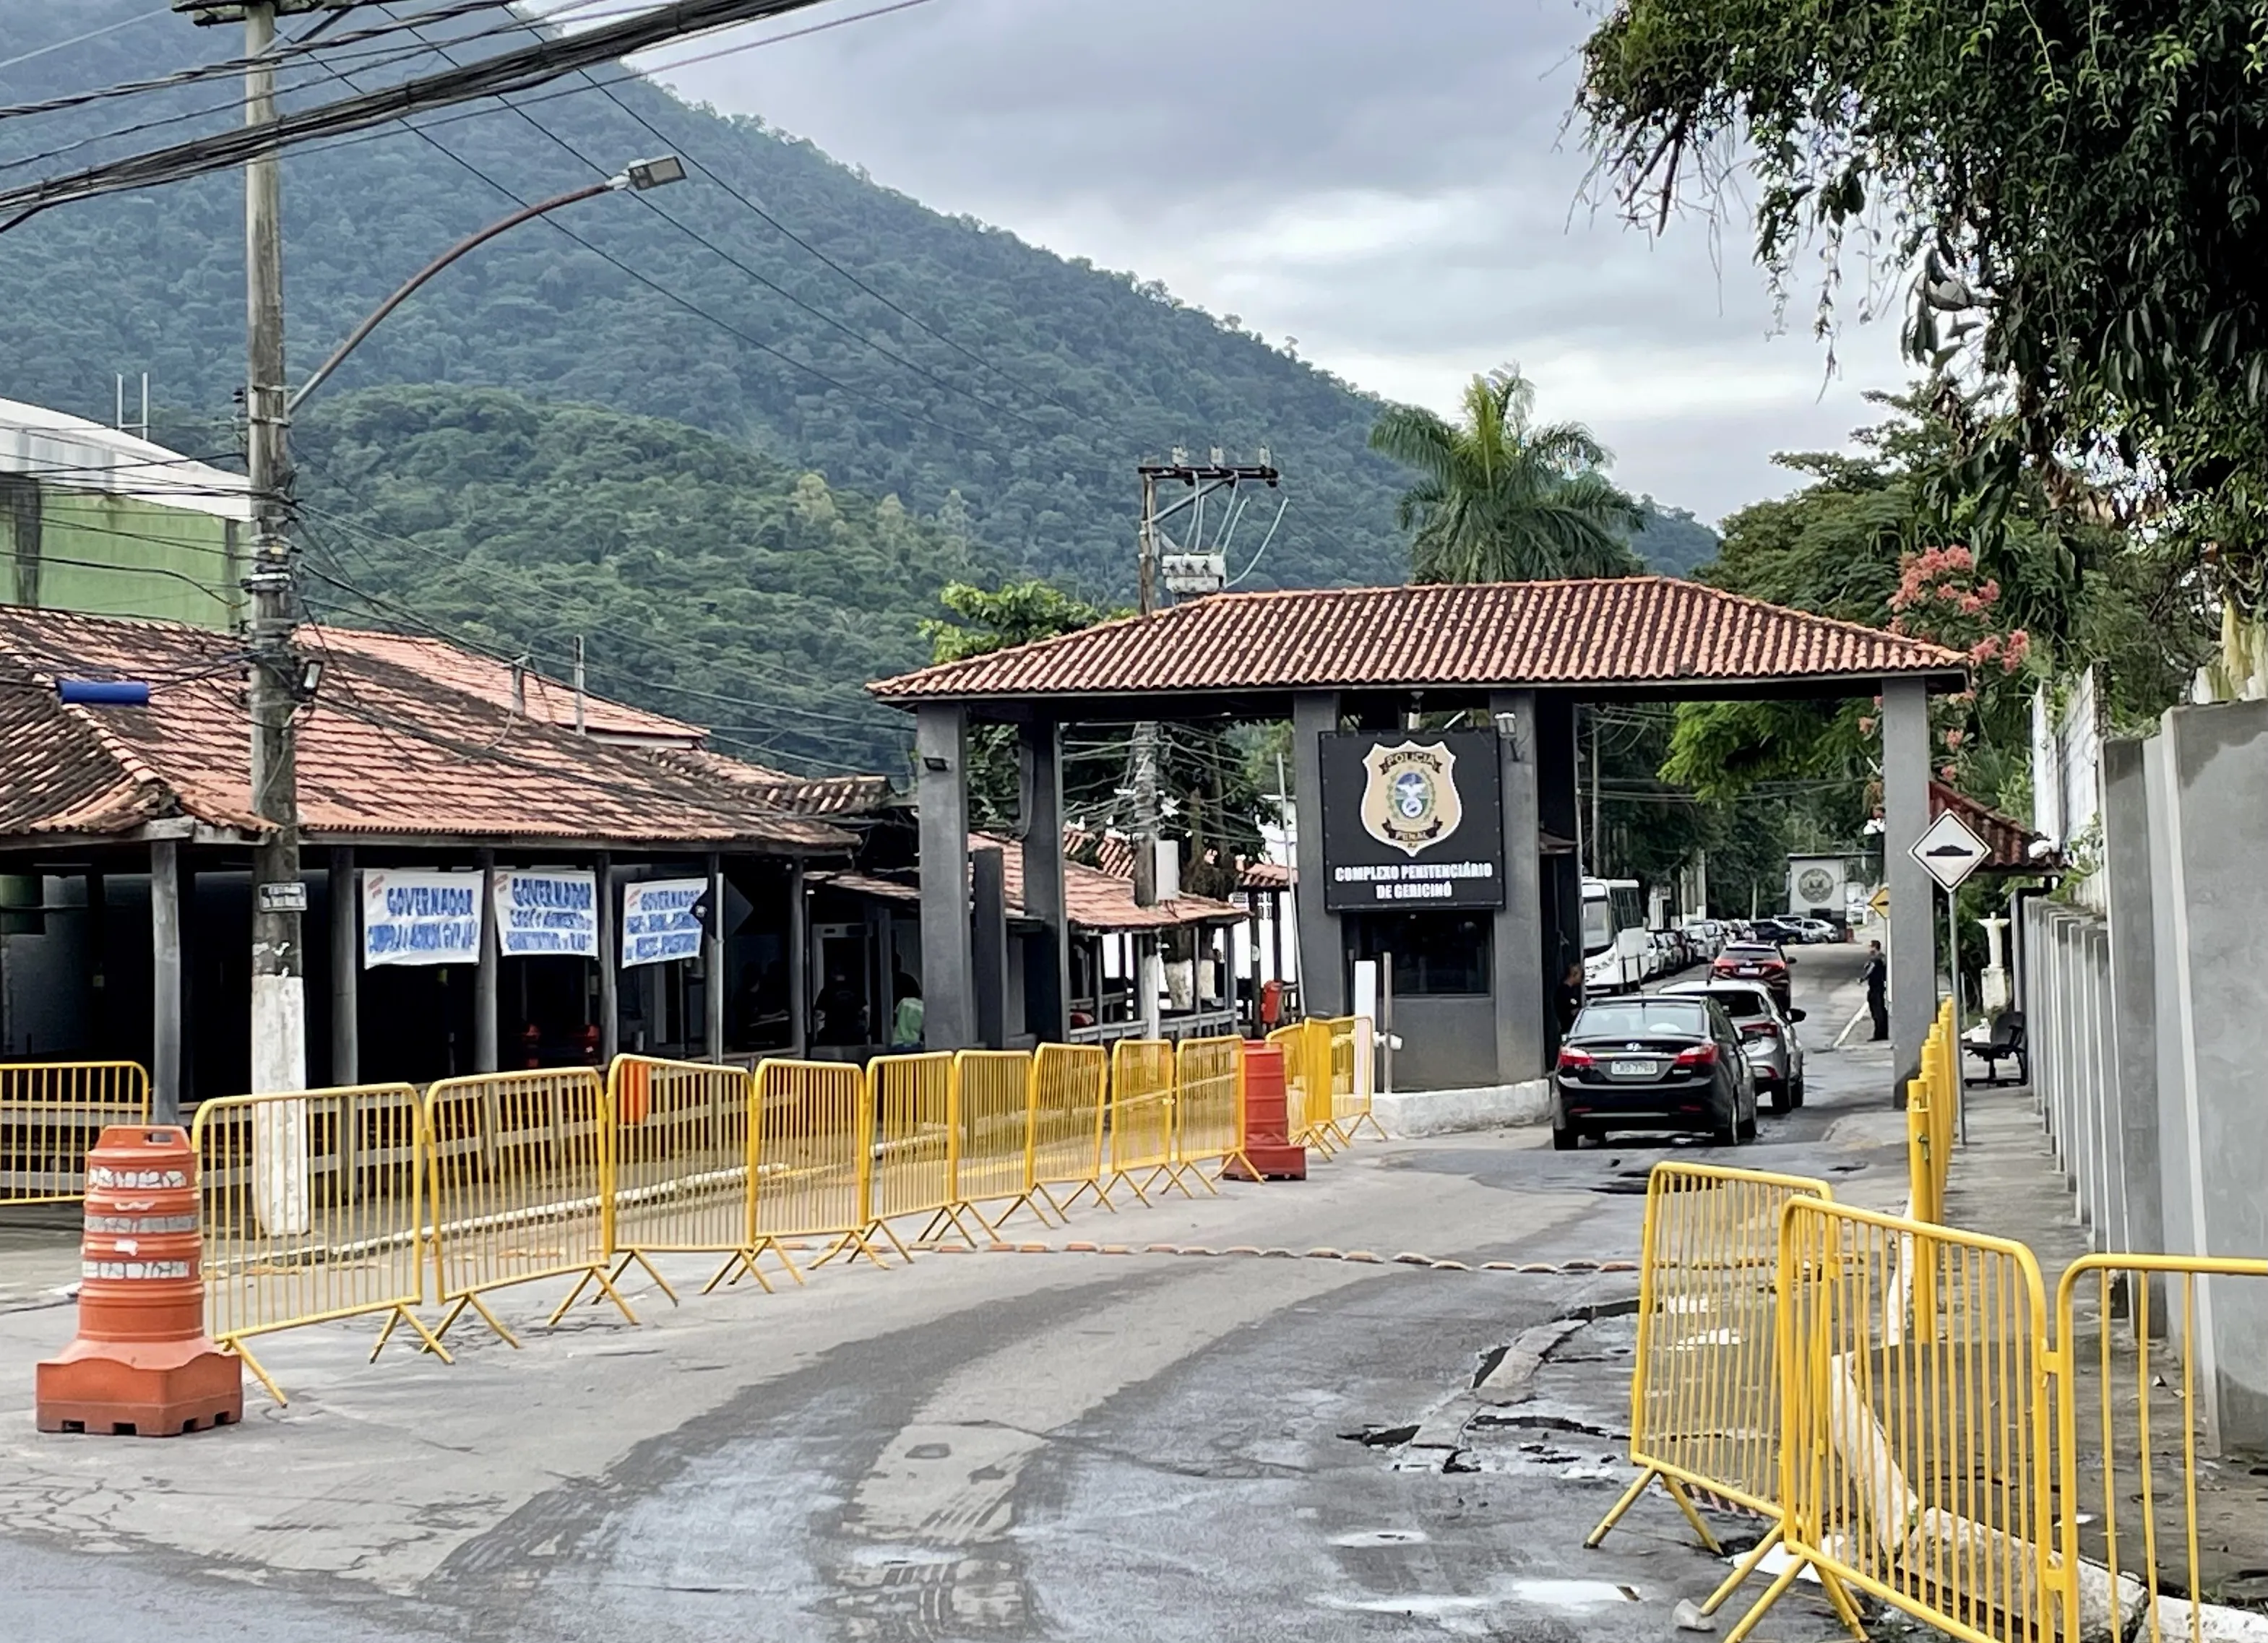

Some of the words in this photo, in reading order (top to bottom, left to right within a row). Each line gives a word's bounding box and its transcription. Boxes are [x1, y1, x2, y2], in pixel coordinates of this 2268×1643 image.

[1335, 866, 1400, 881] COMPLEXO
[1401, 861, 1493, 880] PENITENCIÁRIO
[1376, 884, 1392, 900] DE
[1394, 881, 1452, 900] GERICINÓ
[387, 887, 473, 916] GOVERNADOR
